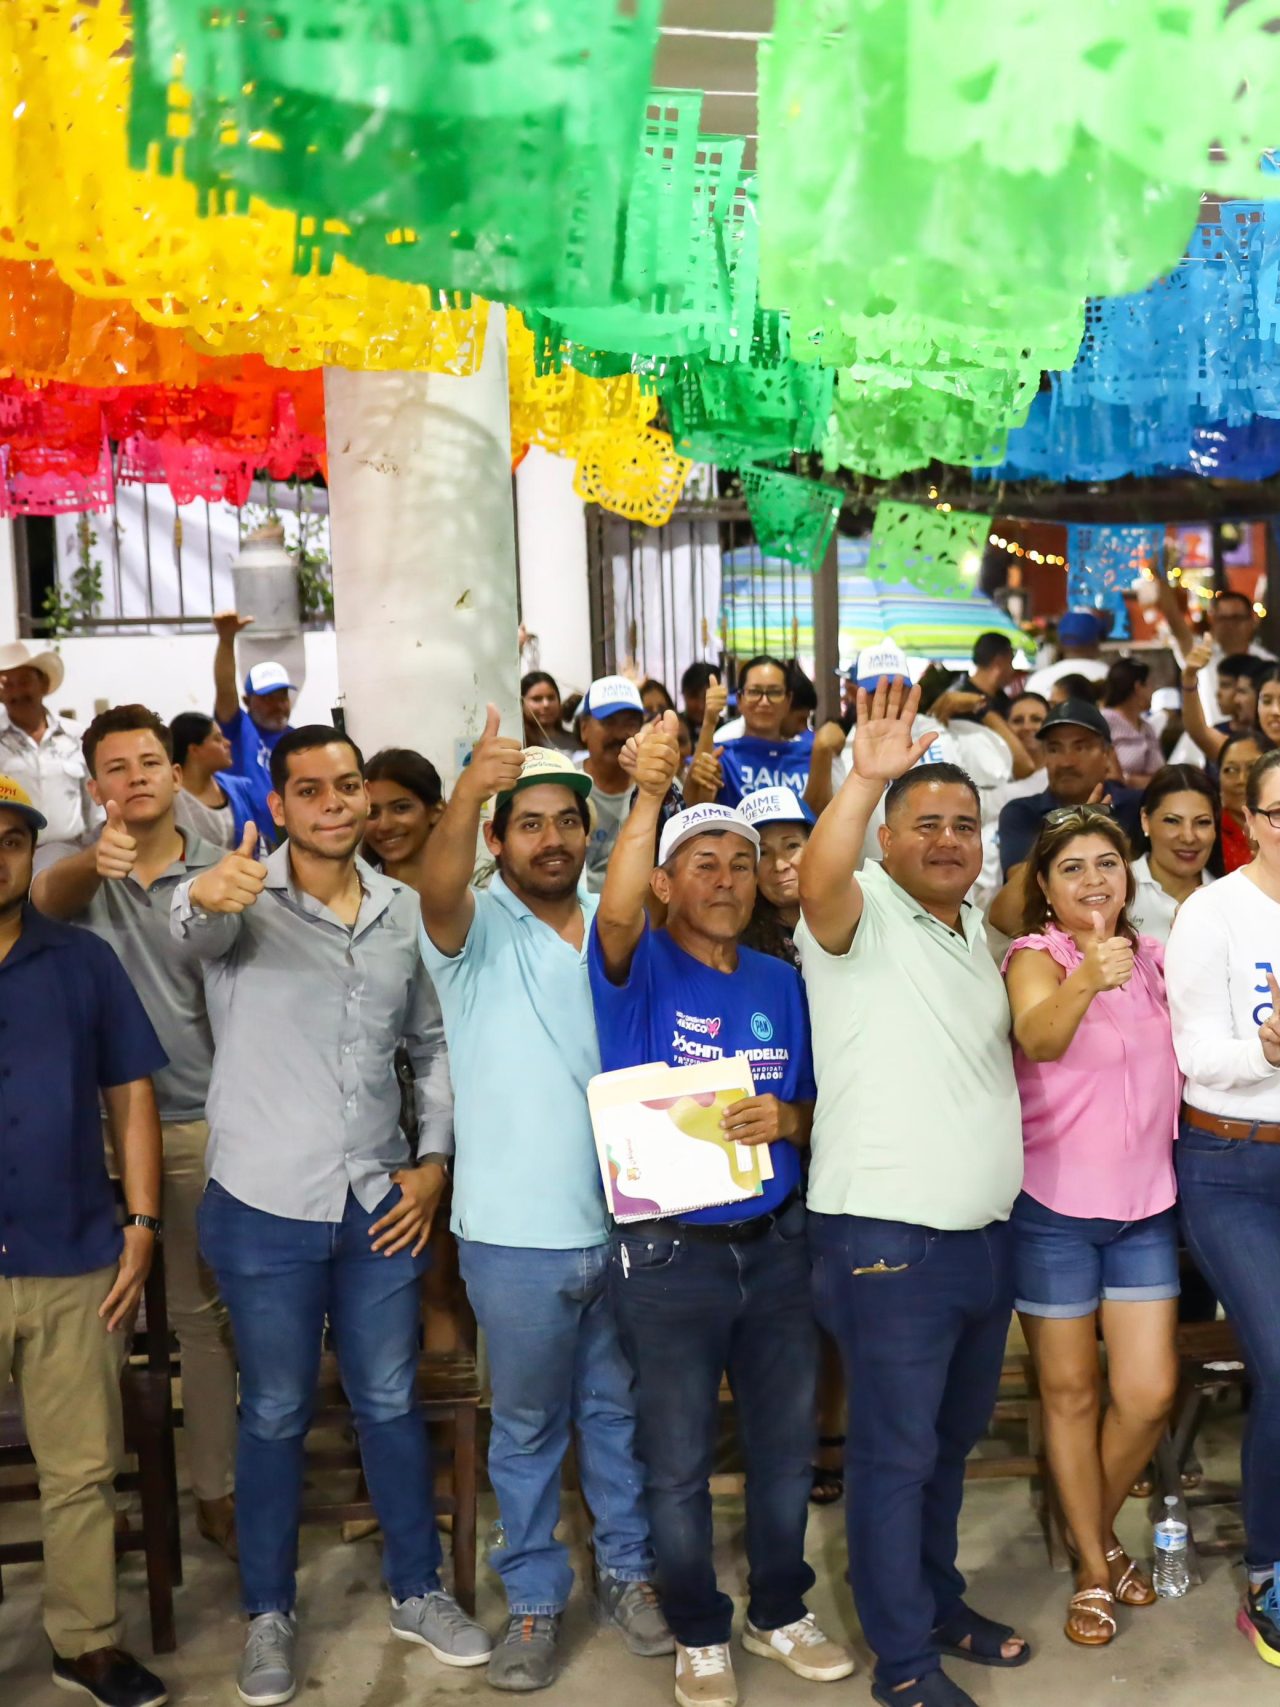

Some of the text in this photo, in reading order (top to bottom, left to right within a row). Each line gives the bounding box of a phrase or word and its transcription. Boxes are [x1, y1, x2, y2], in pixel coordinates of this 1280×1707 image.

[682, 807, 732, 824] JAIME
[745, 805, 781, 821] UEVAS
[754, 1020, 770, 1034] PAN
